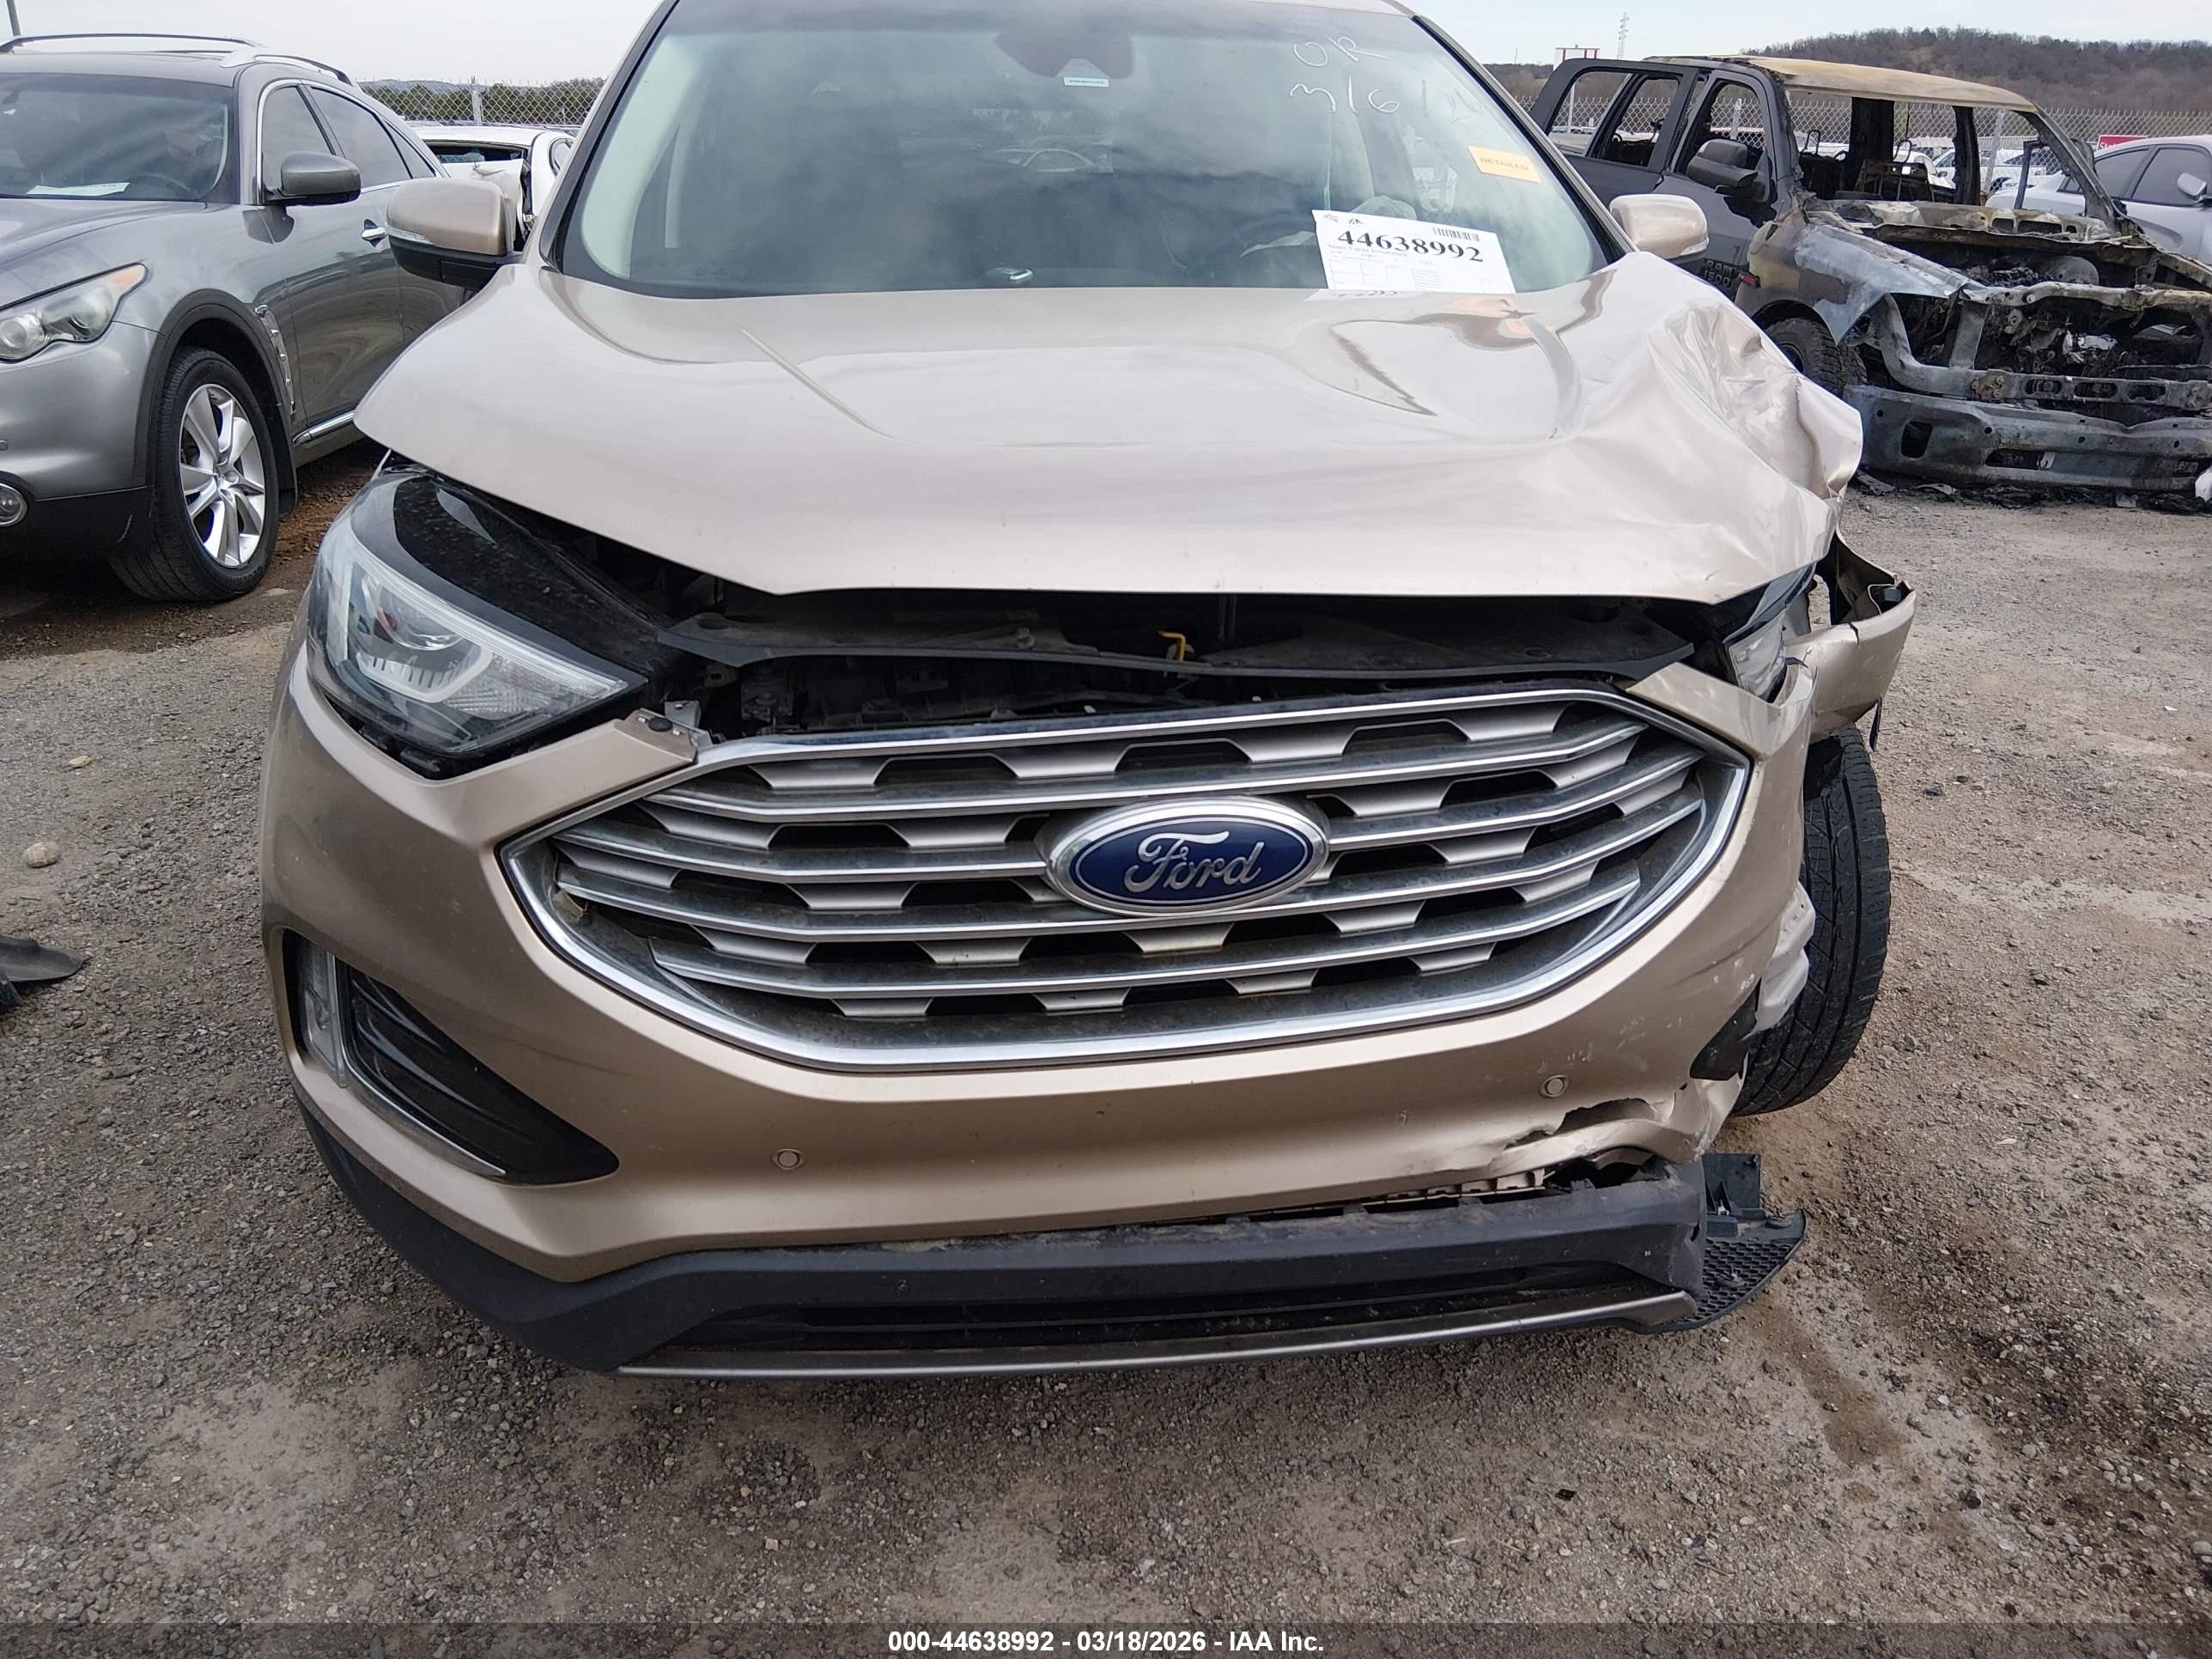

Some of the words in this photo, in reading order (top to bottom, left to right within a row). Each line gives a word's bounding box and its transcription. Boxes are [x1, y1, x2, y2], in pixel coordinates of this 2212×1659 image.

[1480, 157, 1529, 171] DETAILED
[1338, 230, 1484, 262] 44638992
[1705, 259, 1736, 277] RAM
[1703, 270, 1733, 289] 1500
[1124, 830, 1265, 892] Ford
